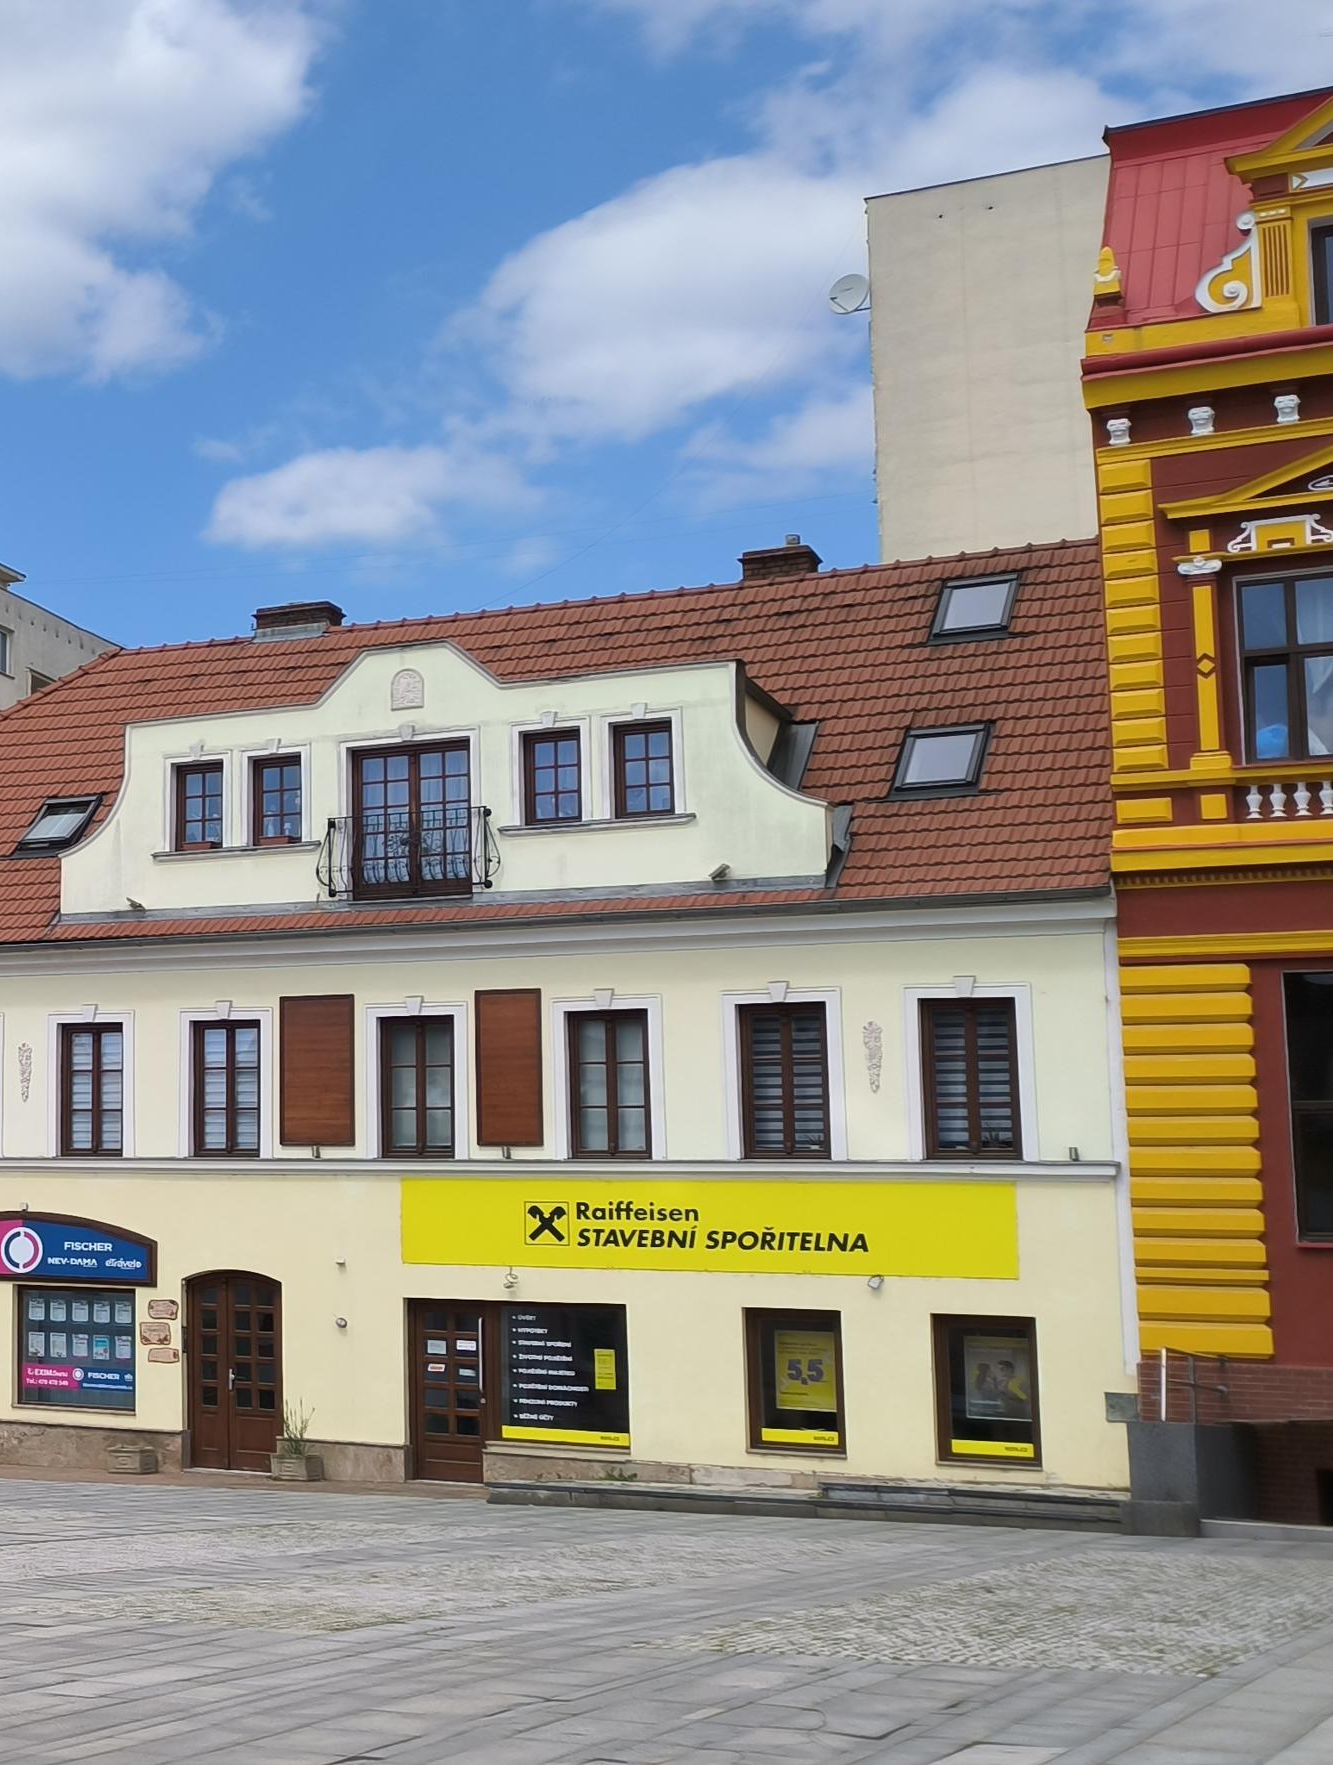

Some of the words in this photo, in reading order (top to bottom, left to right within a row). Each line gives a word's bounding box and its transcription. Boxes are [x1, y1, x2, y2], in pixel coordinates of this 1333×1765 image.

[576, 1200, 700, 1222] Raiffeisen
[64, 1241, 113, 1252] FISCHER
[577, 1226, 697, 1249] STAVEBNÍ
[705, 1226, 870, 1253] SPOŘITELNA
[787, 1359, 824, 1386] 5,5
